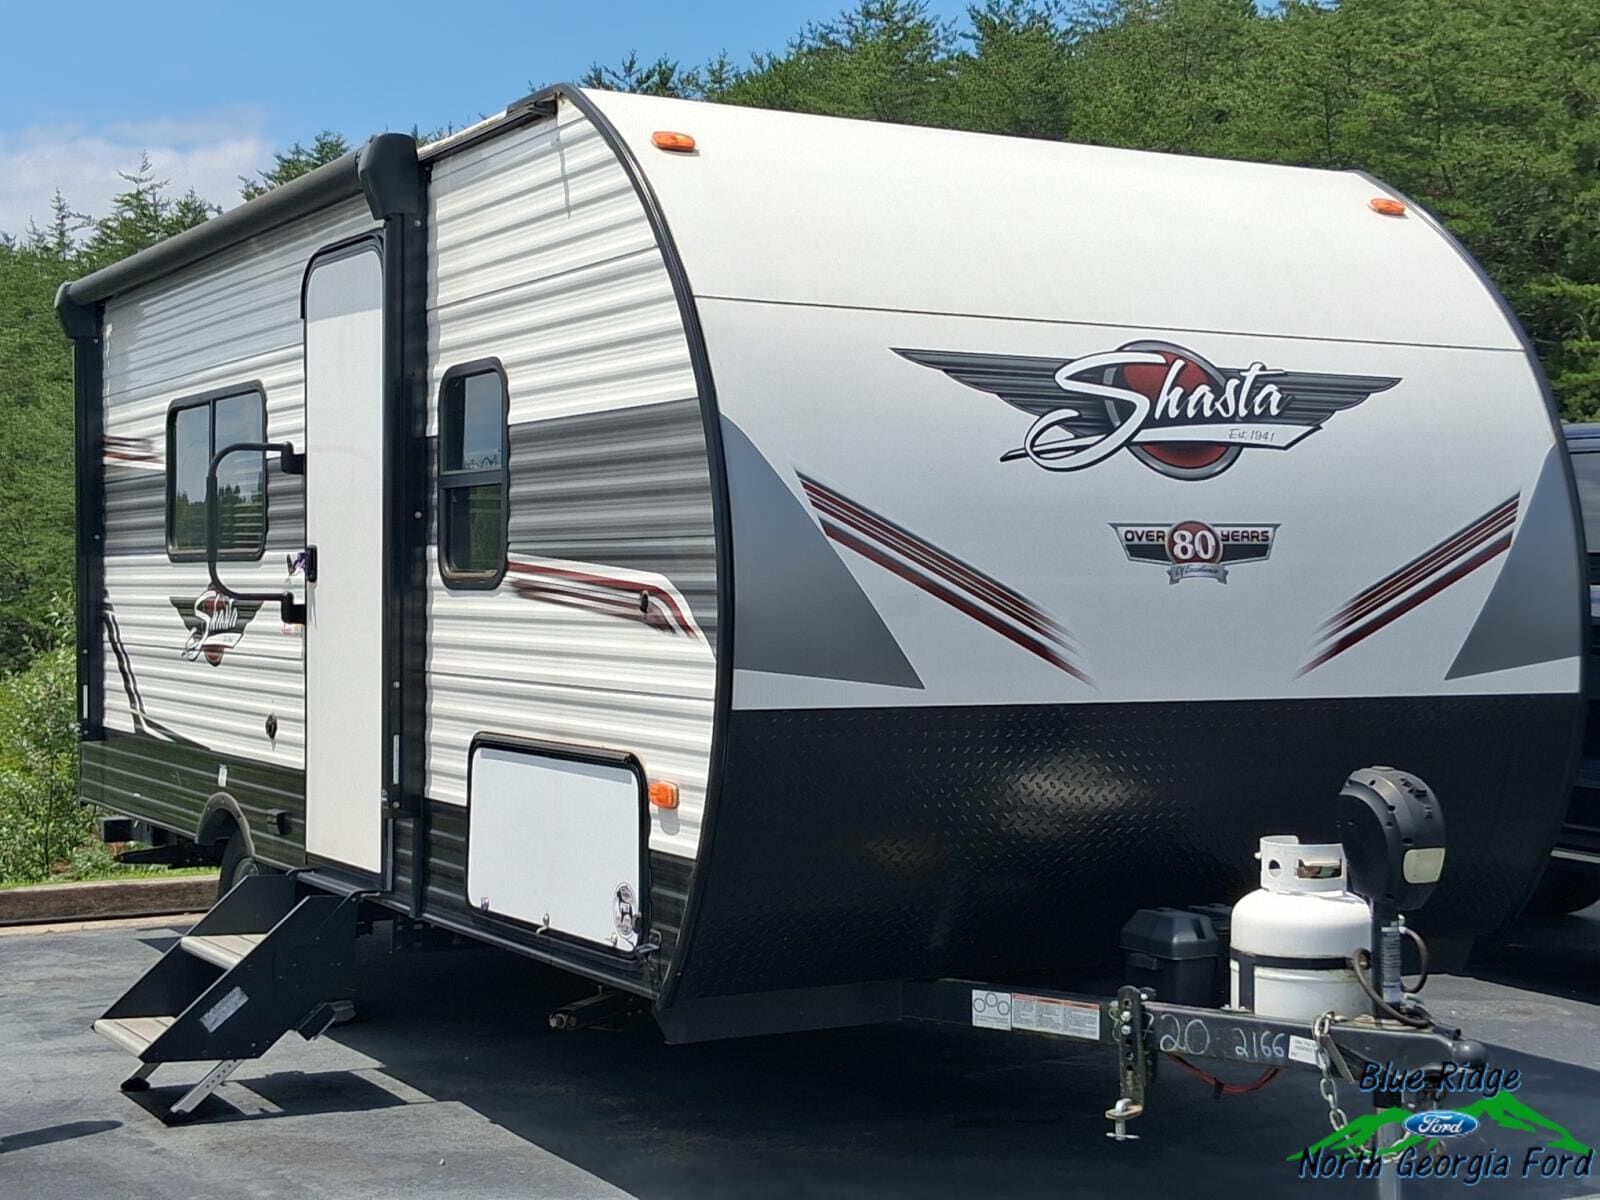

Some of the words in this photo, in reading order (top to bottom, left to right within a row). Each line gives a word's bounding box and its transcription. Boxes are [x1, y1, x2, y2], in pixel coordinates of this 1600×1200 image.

[1002, 351, 1290, 472] Shasta
[1250, 430, 1275, 442] 1941
[1124, 529, 1166, 543] OVER
[1172, 529, 1216, 561] 80
[1221, 530, 1270, 543] YEARS
[1232, 1028, 1286, 1058] 2166
